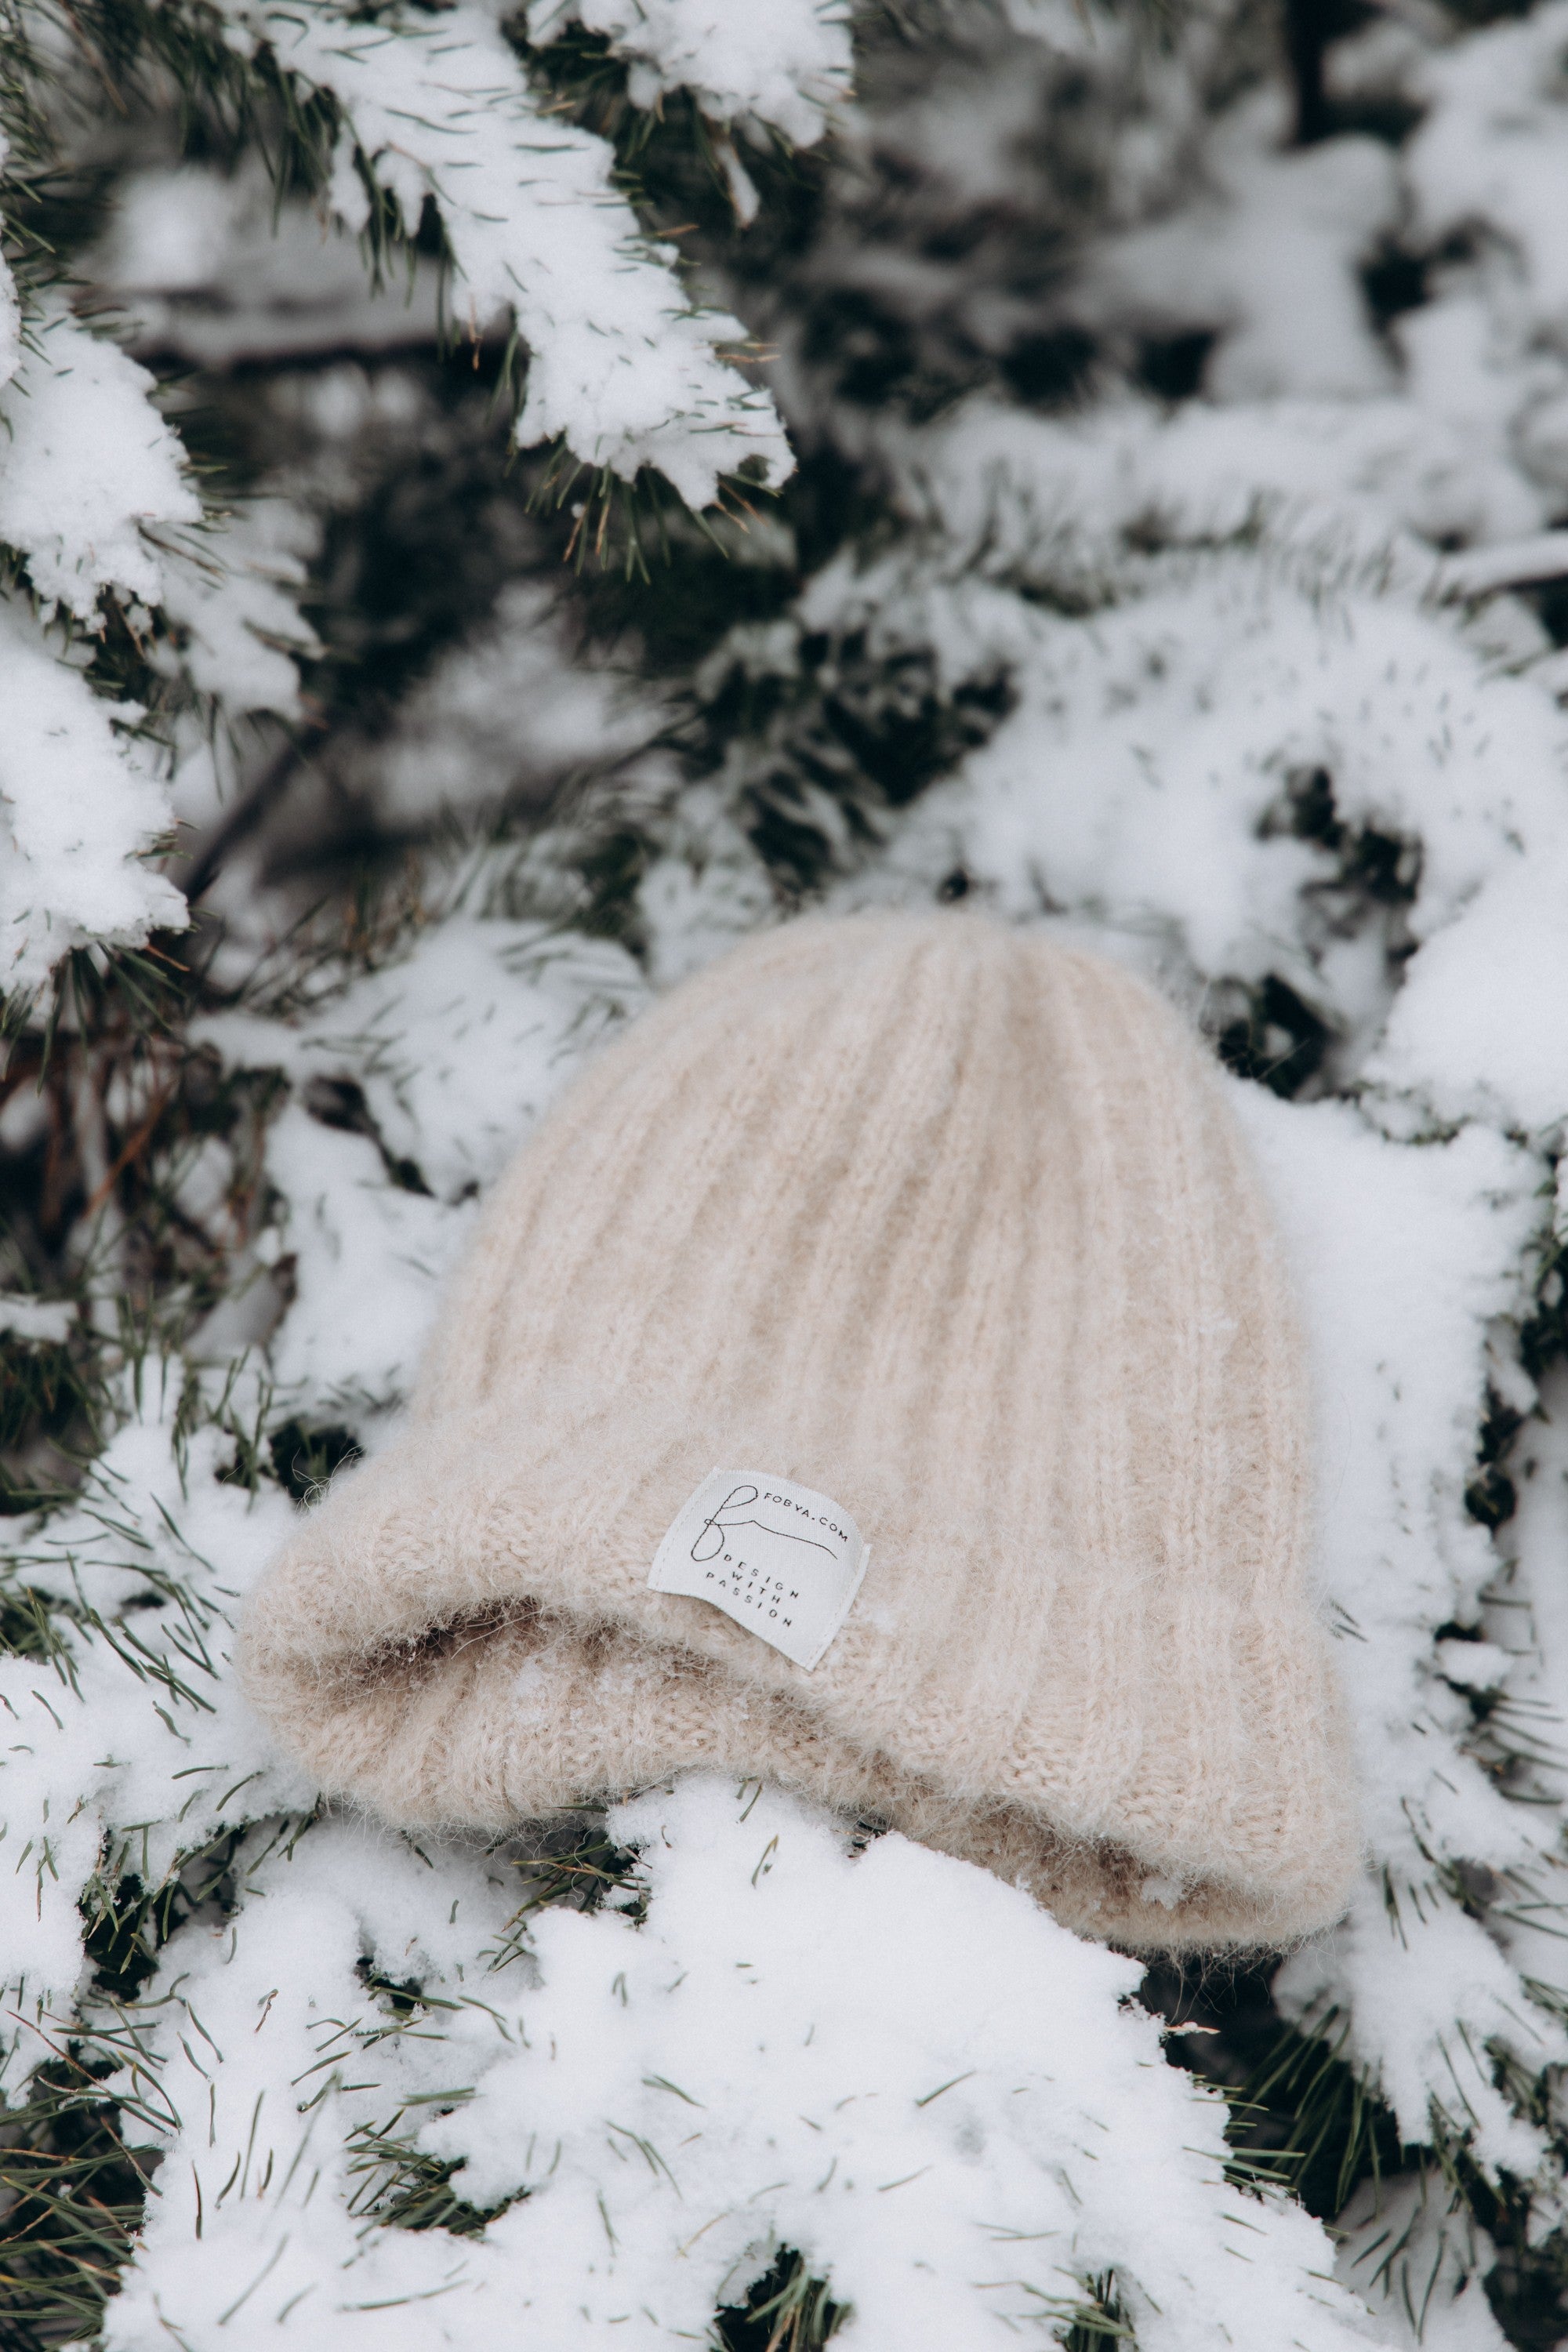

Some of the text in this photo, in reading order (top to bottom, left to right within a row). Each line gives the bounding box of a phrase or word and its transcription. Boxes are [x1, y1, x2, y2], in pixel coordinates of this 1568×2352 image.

[764, 1492, 848, 1542] FOBYA.COM
[706, 1572, 792, 1627] PASSION
[724, 1554, 799, 1599] DESIGN
[732, 1571, 781, 1604] WITH
